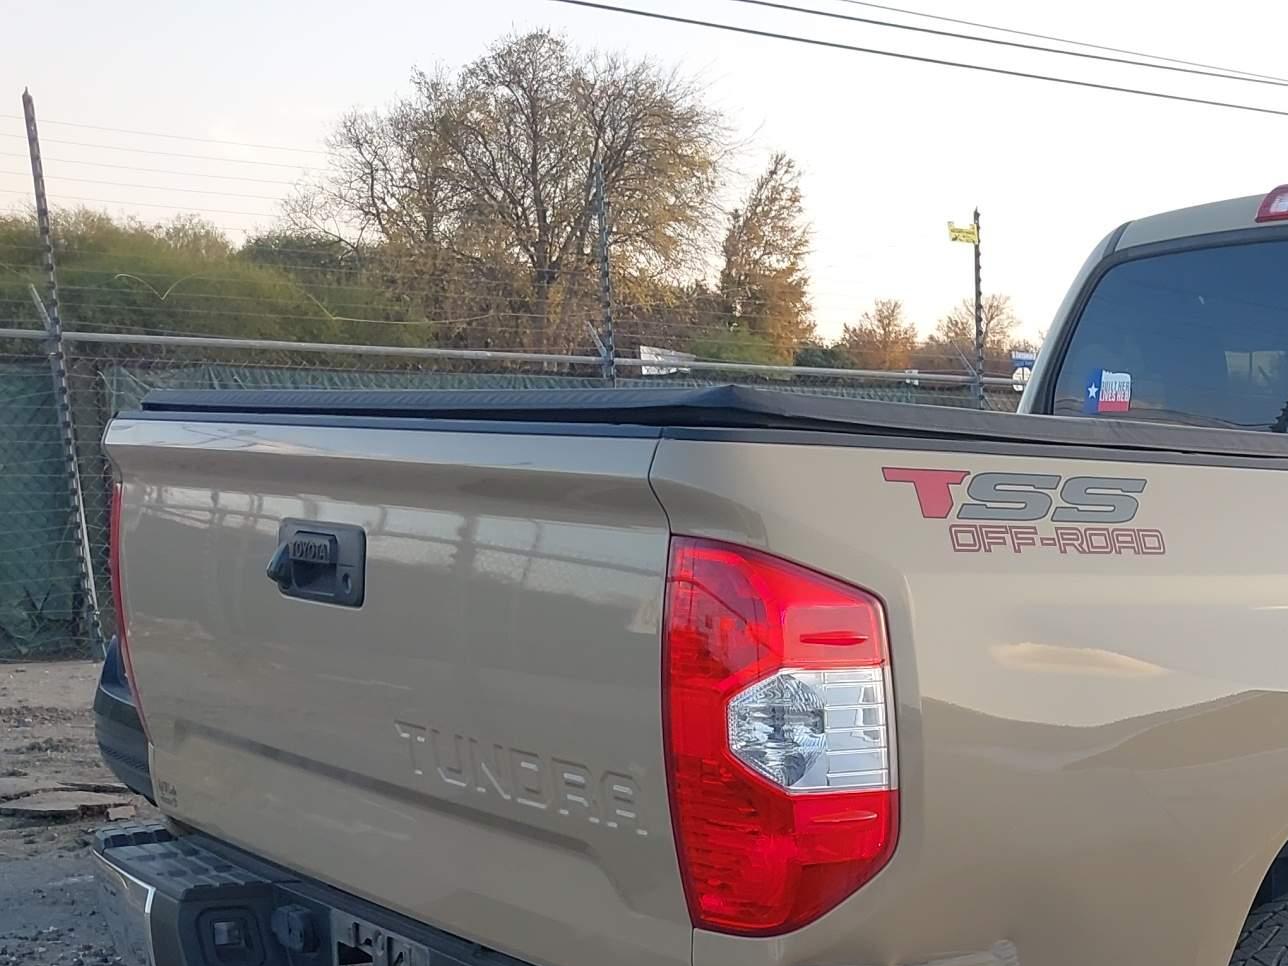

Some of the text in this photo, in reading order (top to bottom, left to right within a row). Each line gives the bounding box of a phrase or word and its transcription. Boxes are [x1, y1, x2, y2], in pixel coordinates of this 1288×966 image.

[881, 466, 1147, 523] TSS
[291, 540, 329, 561] TOYOTA
[949, 524, 1166, 555] OFF-ROAD
[394, 719, 648, 836] TUNDRA
